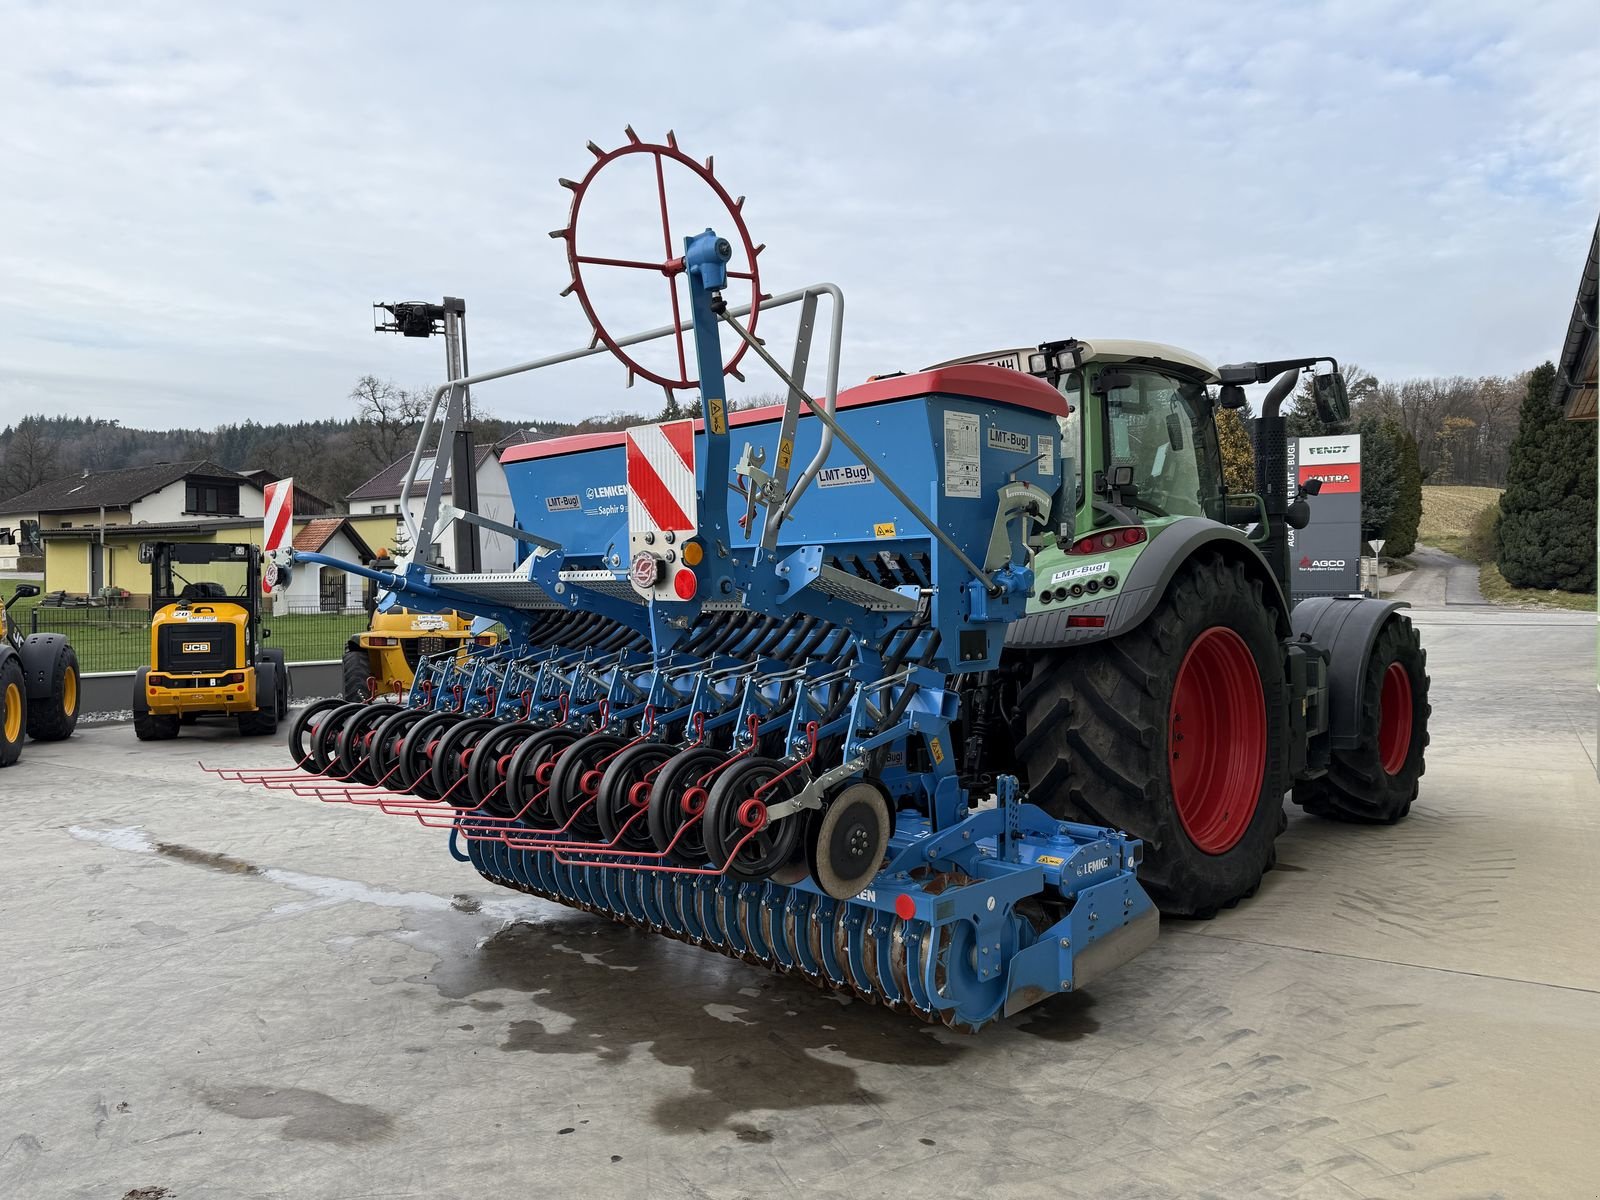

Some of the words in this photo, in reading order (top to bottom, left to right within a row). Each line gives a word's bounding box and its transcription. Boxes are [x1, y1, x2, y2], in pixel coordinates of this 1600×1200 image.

[989, 429, 1029, 449] LMT-Bugl
[1287, 442, 1296, 465] BUGL
[1309, 445, 1350, 455] FENDT
[819, 467, 870, 482] LMT-Bugl
[1287, 472, 1295, 489] LMT
[547, 495, 580, 507] LMT-Bugl
[598, 504, 619, 516] Saphir
[1055, 563, 1106, 580] LMT-Bugl
[1084, 856, 1113, 875] LEMKEN
